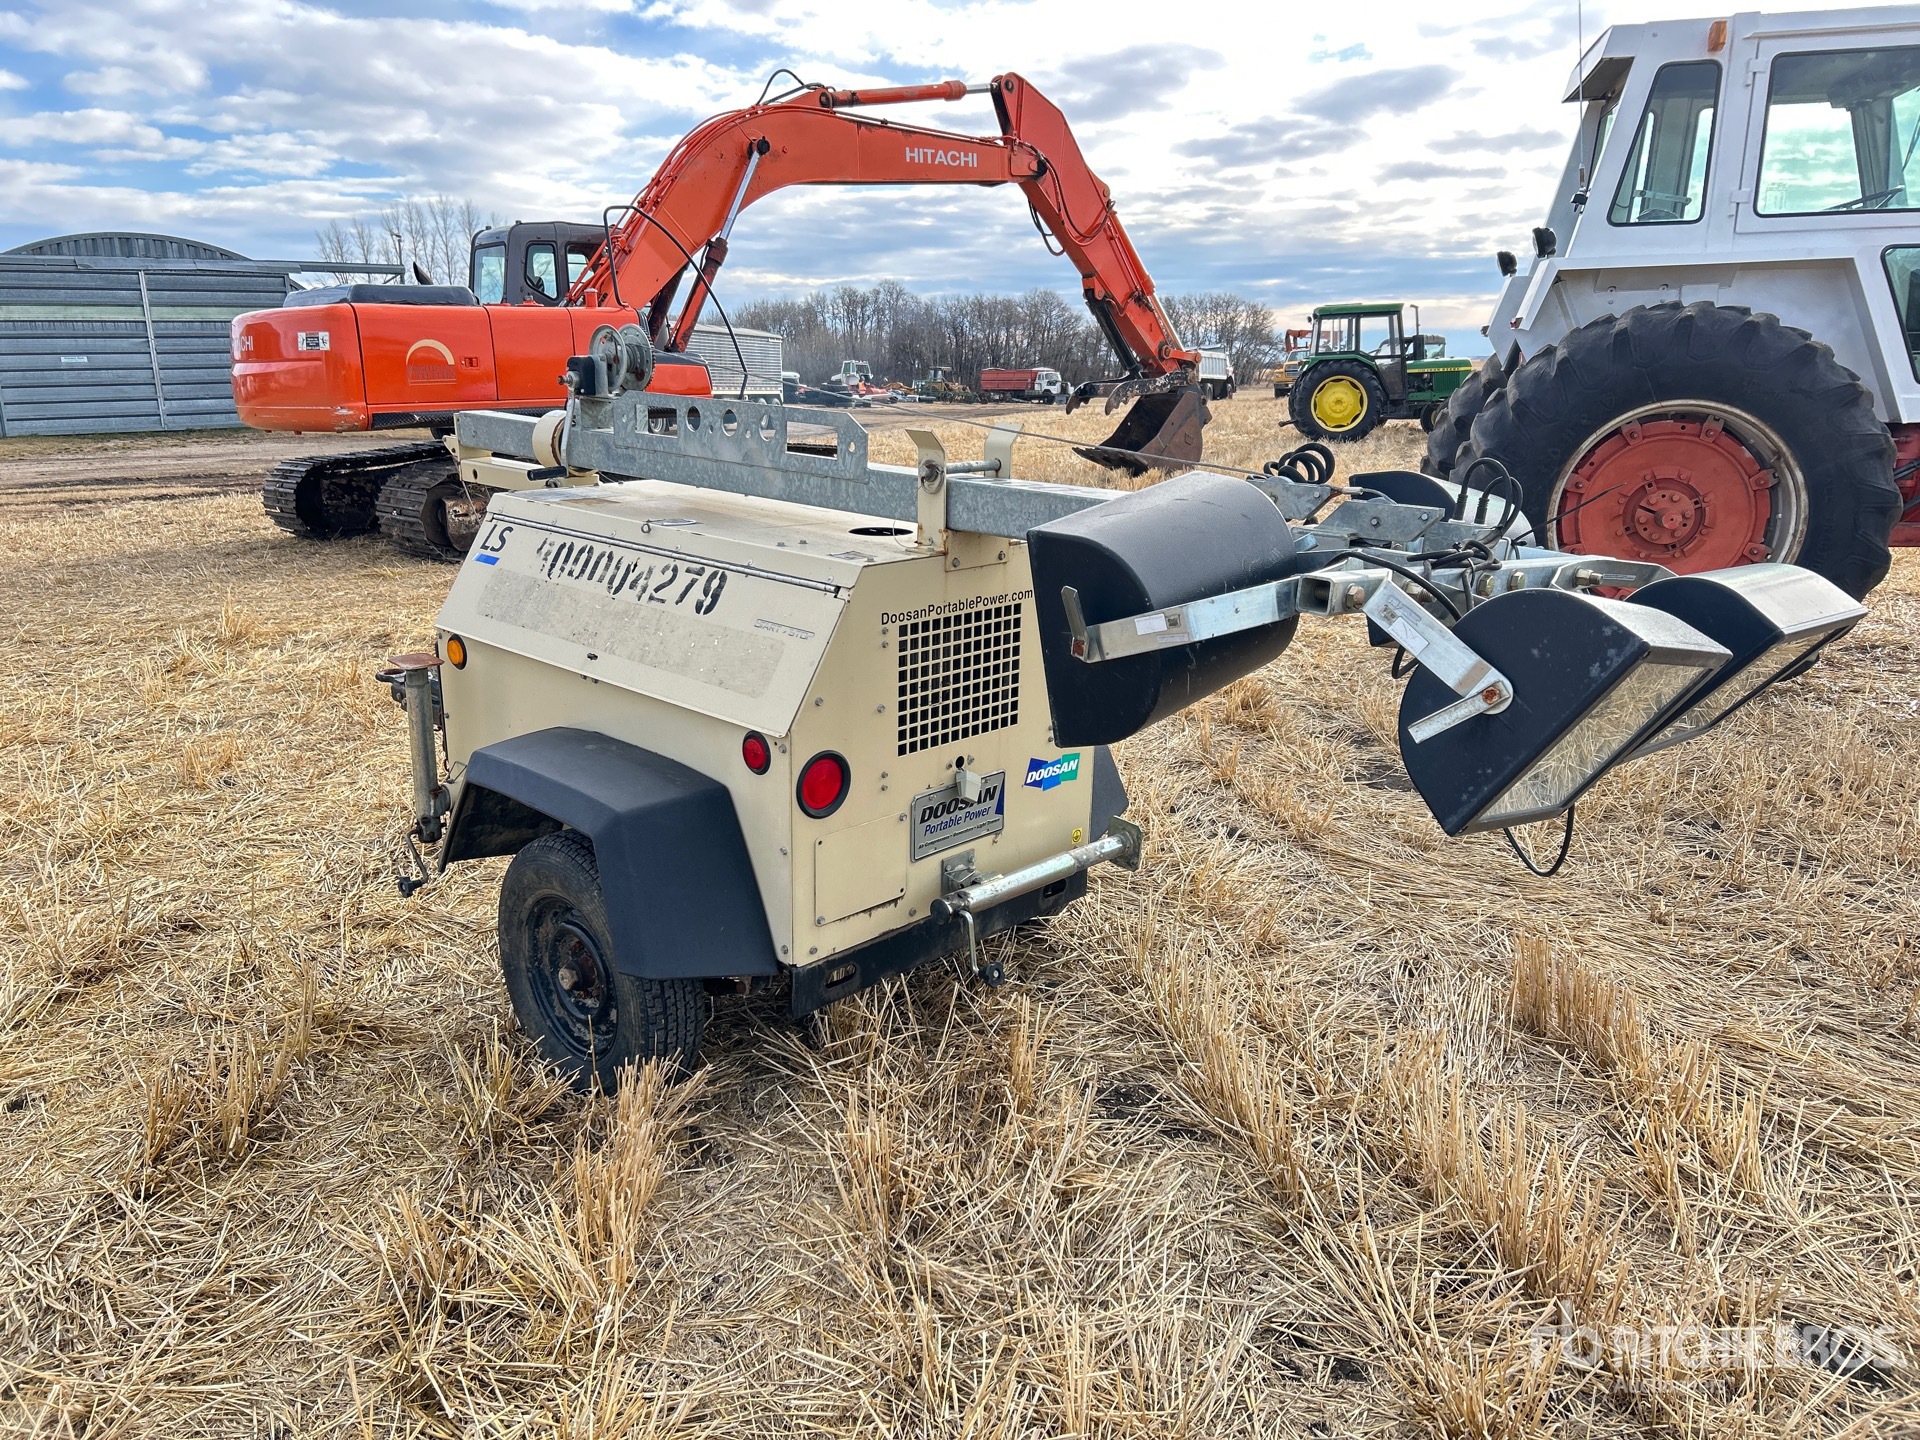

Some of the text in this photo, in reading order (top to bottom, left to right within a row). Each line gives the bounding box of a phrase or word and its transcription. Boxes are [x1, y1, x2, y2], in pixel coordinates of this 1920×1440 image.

[905, 146, 978, 168] HITACHI
[480, 523, 514, 552] LS
[881, 588, 1033, 625] DoosanPortablePower.com
[1026, 759, 1079, 784] DOOSAN
[924, 806, 991, 837] Portable Power
